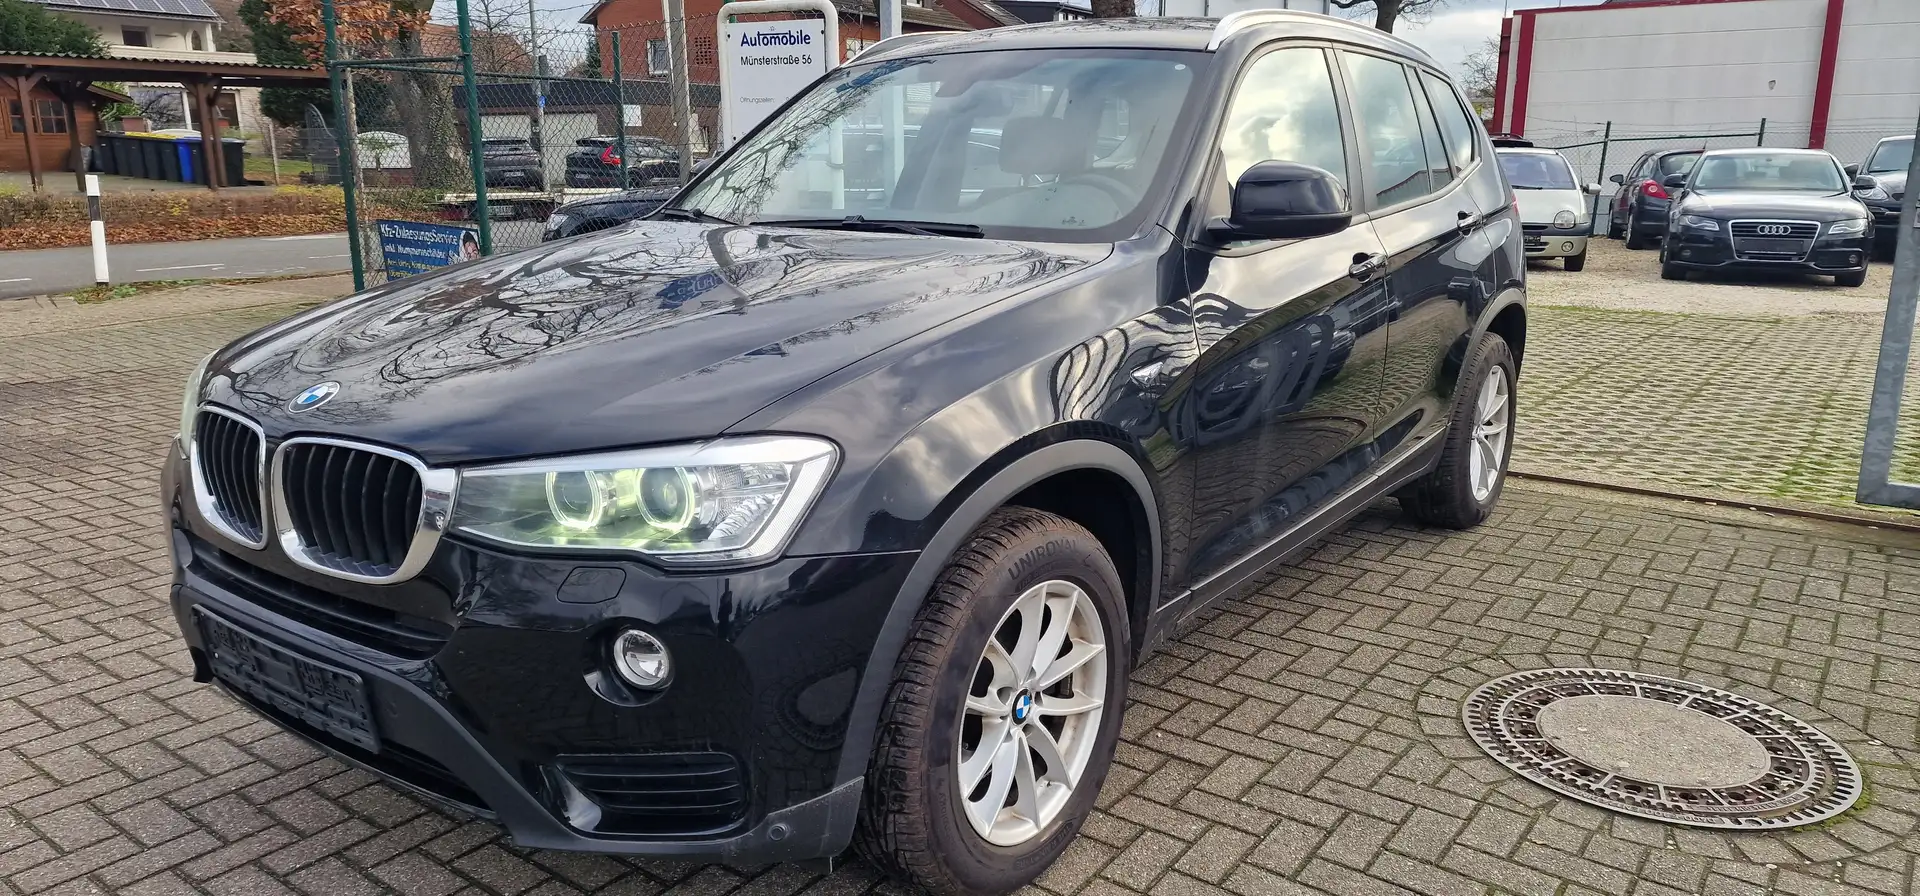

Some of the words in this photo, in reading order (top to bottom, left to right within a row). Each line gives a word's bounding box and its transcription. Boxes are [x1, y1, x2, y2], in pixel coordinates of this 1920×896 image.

[740, 29, 811, 47] Automobile
[740, 55, 800, 66] Münsterstraße
[801, 54, 812, 65] 56
[1007, 539, 1077, 580] UNIROYAL
